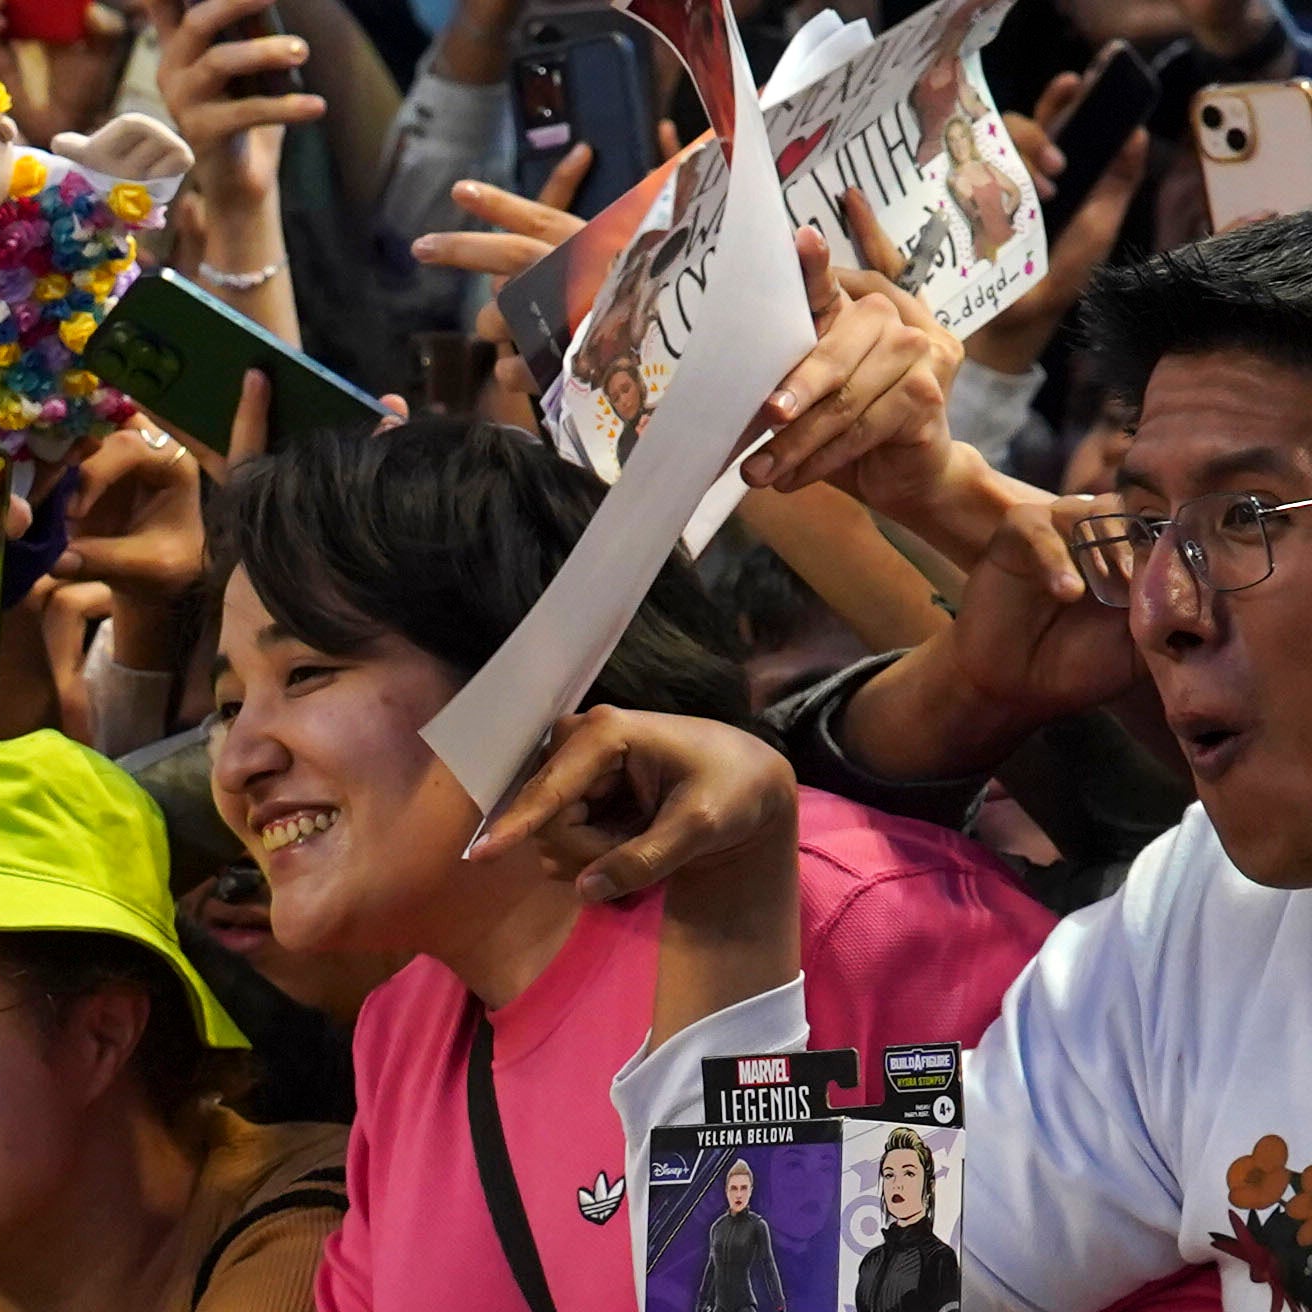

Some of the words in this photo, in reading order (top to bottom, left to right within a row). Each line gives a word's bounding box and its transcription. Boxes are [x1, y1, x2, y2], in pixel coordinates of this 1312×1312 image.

[738, 1058, 790, 1084] MARVEL
[720, 1085, 811, 1123] LEGENDS
[697, 1129, 743, 1147] YELENA
[747, 1126, 794, 1145] BELOVA
